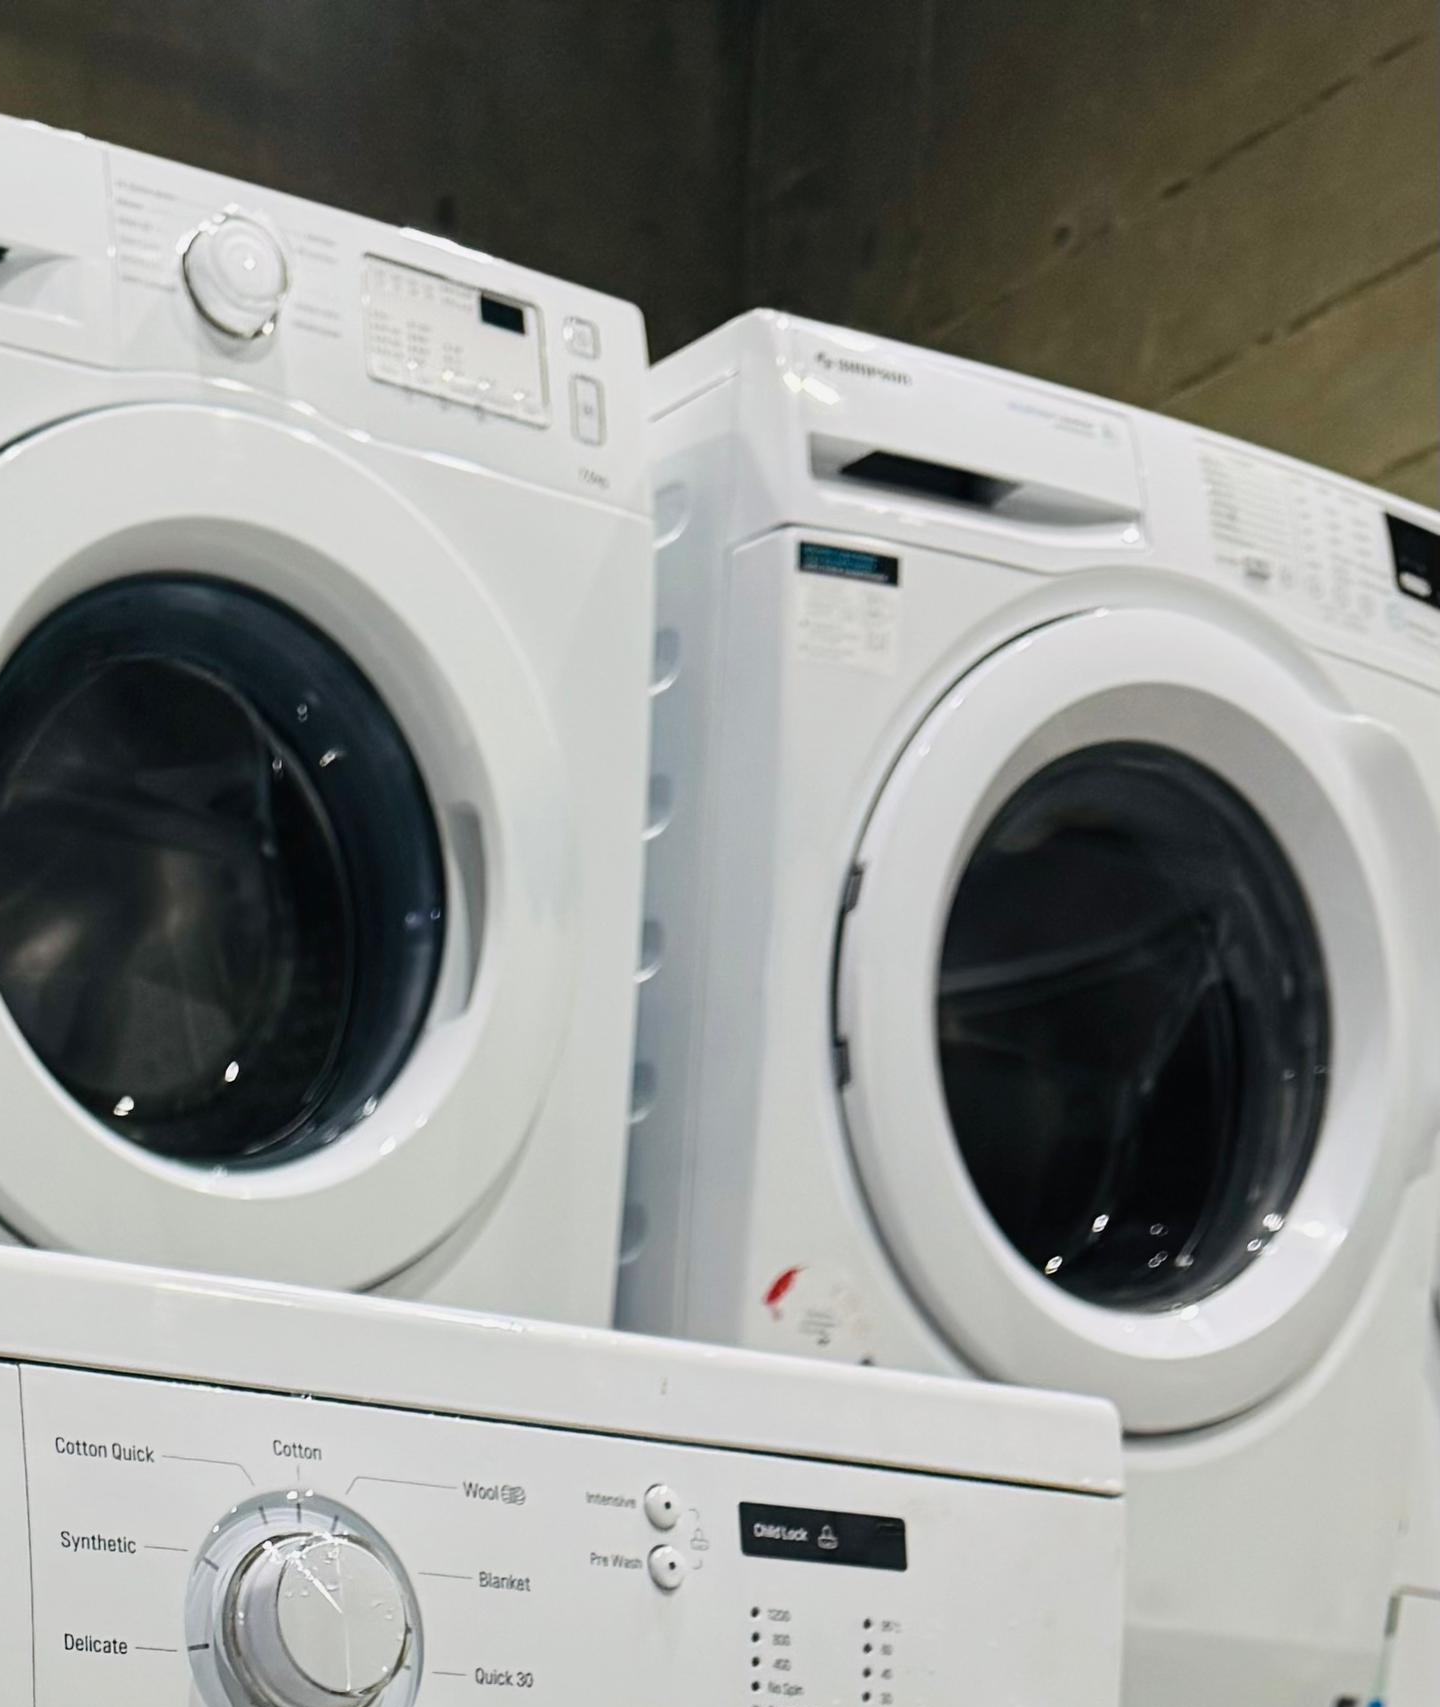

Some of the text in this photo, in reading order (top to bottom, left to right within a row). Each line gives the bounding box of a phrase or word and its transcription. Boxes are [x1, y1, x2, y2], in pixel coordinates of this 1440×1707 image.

[55, 1437, 155, 1463] Cotton Quick
[272, 1440, 322, 1461] Cotton
[463, 1482, 499, 1500] Wool
[586, 1492, 636, 1509] Intensive
[60, 1531, 137, 1555] Synthetic
[753, 1523, 808, 1542] Child Lock
[591, 1552, 643, 1570] Pre Wash
[478, 1570, 530, 1592] Blanket
[64, 1633, 128, 1654] Delicate
[475, 1667, 534, 1688] Quick 30
